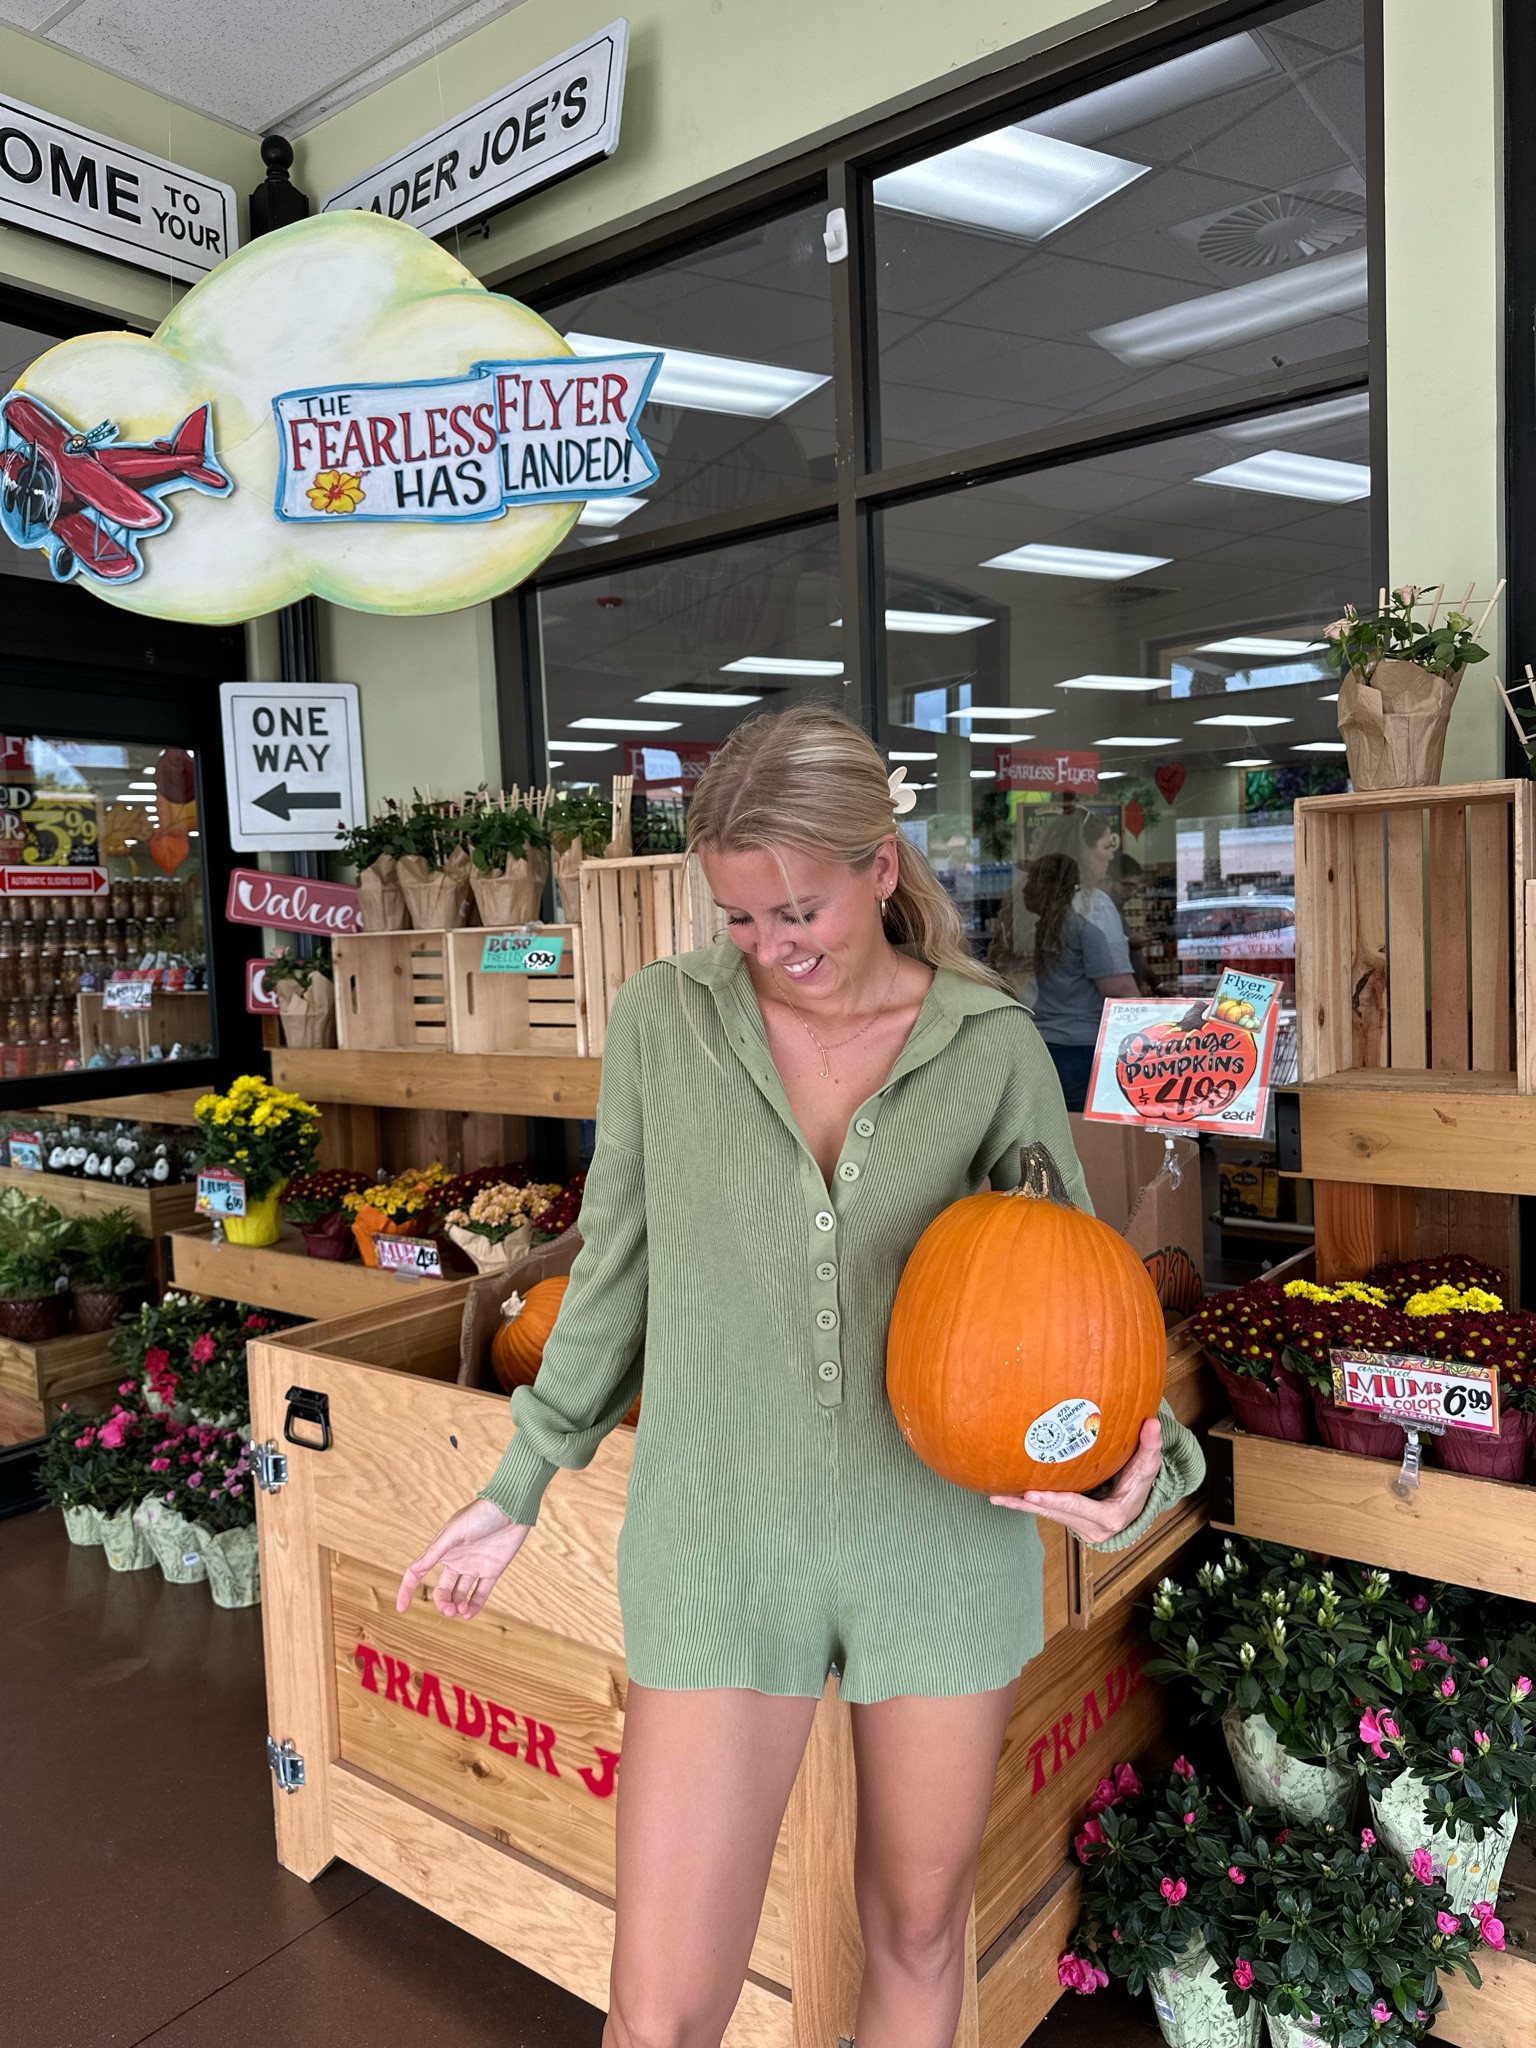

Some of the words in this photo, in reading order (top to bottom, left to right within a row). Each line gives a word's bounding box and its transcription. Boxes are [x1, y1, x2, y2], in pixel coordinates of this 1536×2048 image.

[354, 150, 459, 221] ADER
[469, 76, 588, 180] JOE'S
[164, 185, 201, 215] TO
[152, 207, 220, 254] YOUR
[298, 394, 352, 417] THE
[289, 403, 498, 471] FEARLESS
[496, 373, 629, 434] FLYER
[394, 459, 487, 509] HAS
[500, 436, 633, 491] LANDED!
[252, 706, 329, 737] ONE
[252, 744, 331, 773] WAY
[997, 753, 1056, 781] FEARLESS
[1055, 756, 1098, 785] FLYER
[11, 876, 46, 886] AUTOMATIC
[47, 876, 71, 886] SLIDING
[72, 876, 90, 886] DOOR
[487, 951, 524, 963] TRELLIS
[1248, 943, 1284, 954] WEEK
[1225, 973, 1266, 993] Flyer
[1238, 987, 1273, 1002] item!
[1113, 1006, 1148, 1014] TRADER
[1118, 1032, 1241, 1064] Orange
[1357, 1365, 1413, 1378] assorted
[1347, 1371, 1443, 1399] MUMS
[1057, 1404, 1071, 1418] 4735
[1060, 1401, 1087, 1424] PUMPKIN
[1350, 1390, 1390, 1408] FALL
[1393, 1399, 1441, 1416] COLOR
[1382, 1407, 1456, 1425] SEASONAL
[355, 1643, 561, 1778] TRADER
